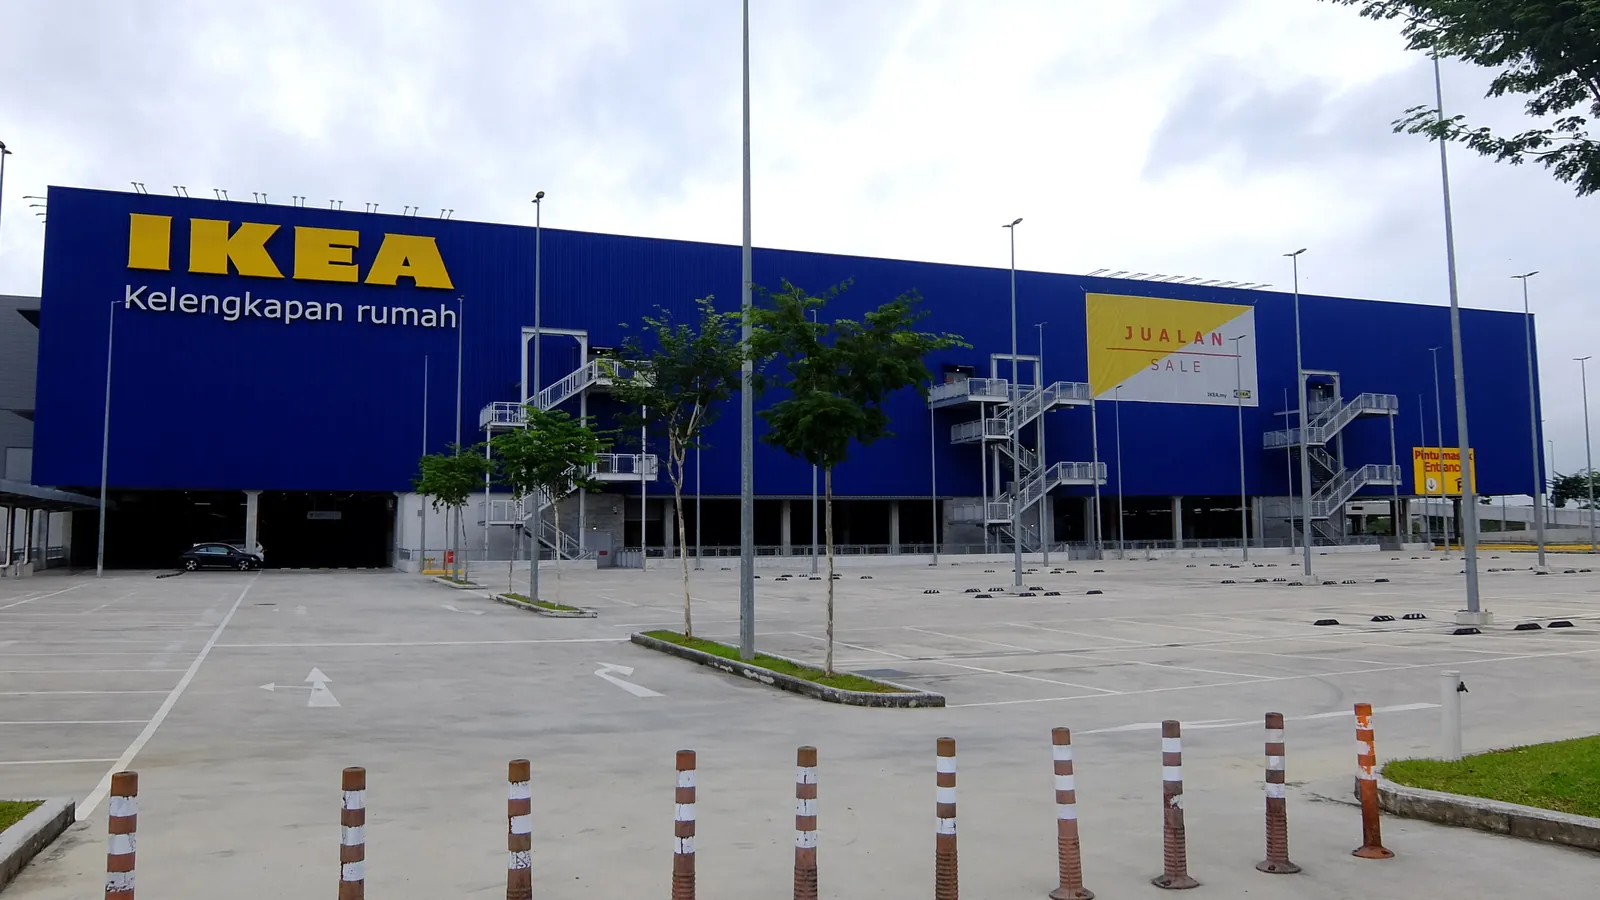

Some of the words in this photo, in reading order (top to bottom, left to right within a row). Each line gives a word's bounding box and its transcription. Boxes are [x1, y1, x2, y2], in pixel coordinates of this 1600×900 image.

[127, 212, 455, 289] IKEA
[125, 284, 343, 324] Kelengkapan
[357, 304, 457, 328] rumah
[1125, 326, 1223, 346] JUALAN
[1151, 359, 1201, 373] SALE
[1414, 450, 1440, 460] Pintu
[1442, 452, 1473, 460] mas
[1425, 462, 1463, 472] Entanc
